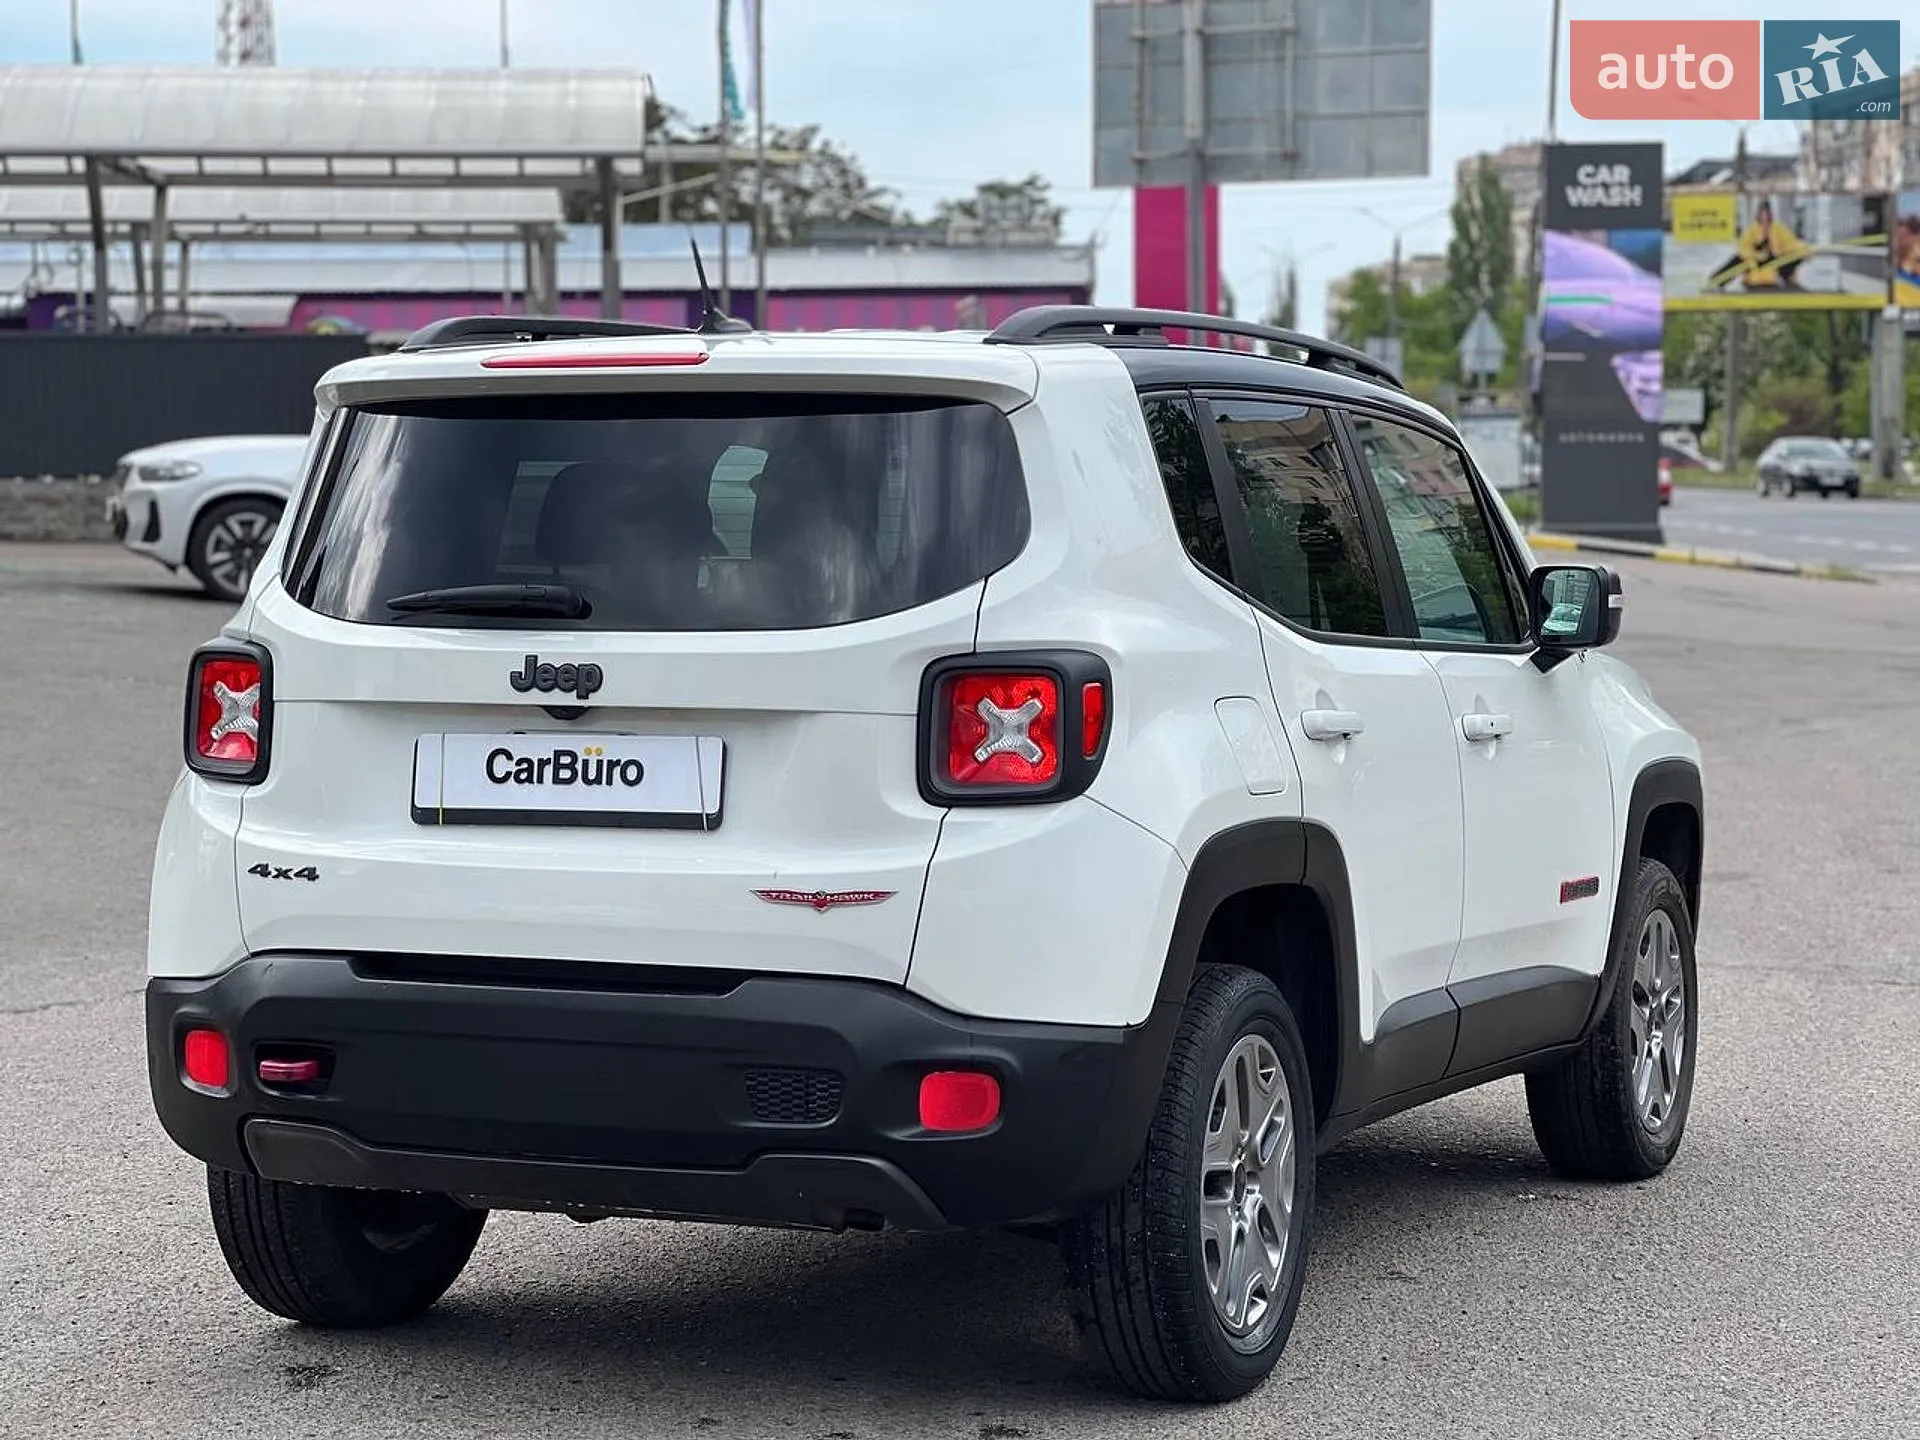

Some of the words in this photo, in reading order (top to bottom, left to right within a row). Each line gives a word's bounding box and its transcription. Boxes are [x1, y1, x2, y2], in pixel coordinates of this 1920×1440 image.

[1576, 164, 1631, 186] CAR
[1565, 185, 1643, 208] WASH
[510, 654, 604, 700] Jeep
[486, 746, 645, 787] CarBüro
[247, 862, 320, 882] 4x4
